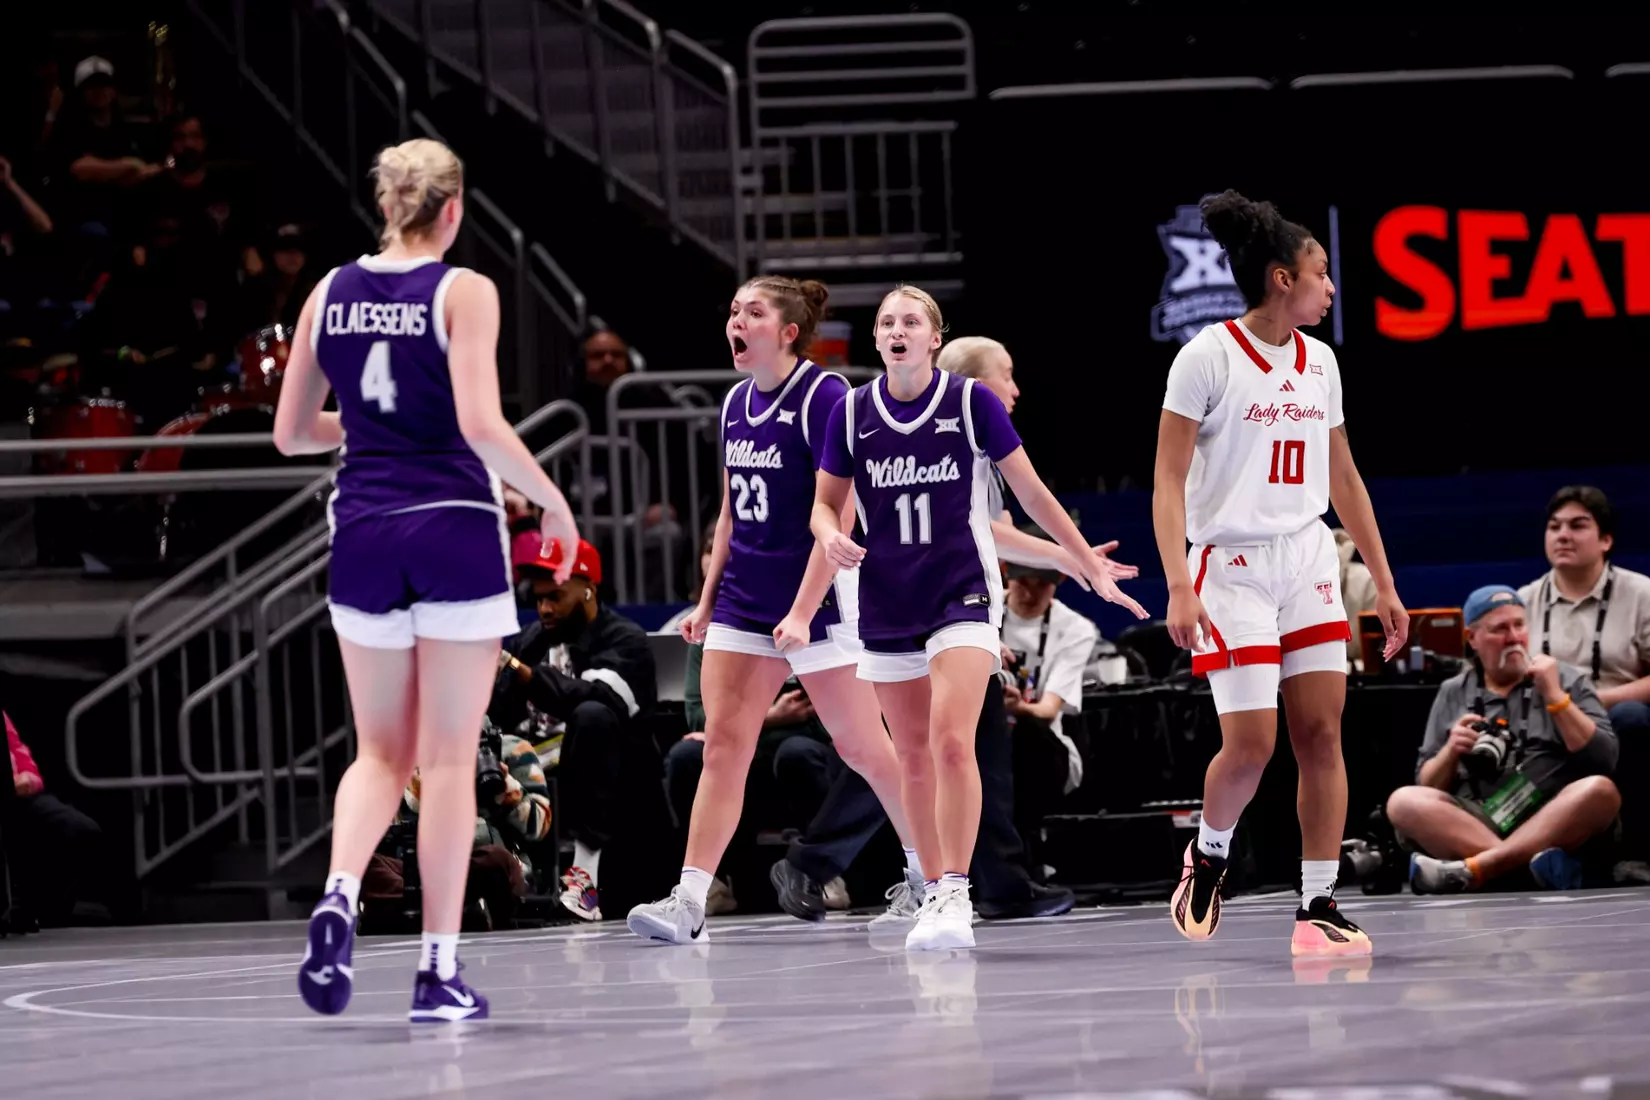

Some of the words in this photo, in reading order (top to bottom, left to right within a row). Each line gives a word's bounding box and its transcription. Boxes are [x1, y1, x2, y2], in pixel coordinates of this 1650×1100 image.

[1373, 205, 1650, 341] SEAT
[326, 302, 428, 336] CLAESSENS
[360, 340, 398, 414] 4
[1243, 402, 1279, 426] Lady
[1282, 403, 1325, 421] Raiders
[726, 439, 783, 469] Wildcats
[866, 453, 960, 488] Wildcats
[1268, 440, 1305, 484] 10
[730, 473, 769, 523] 23
[894, 492, 932, 545] 11
